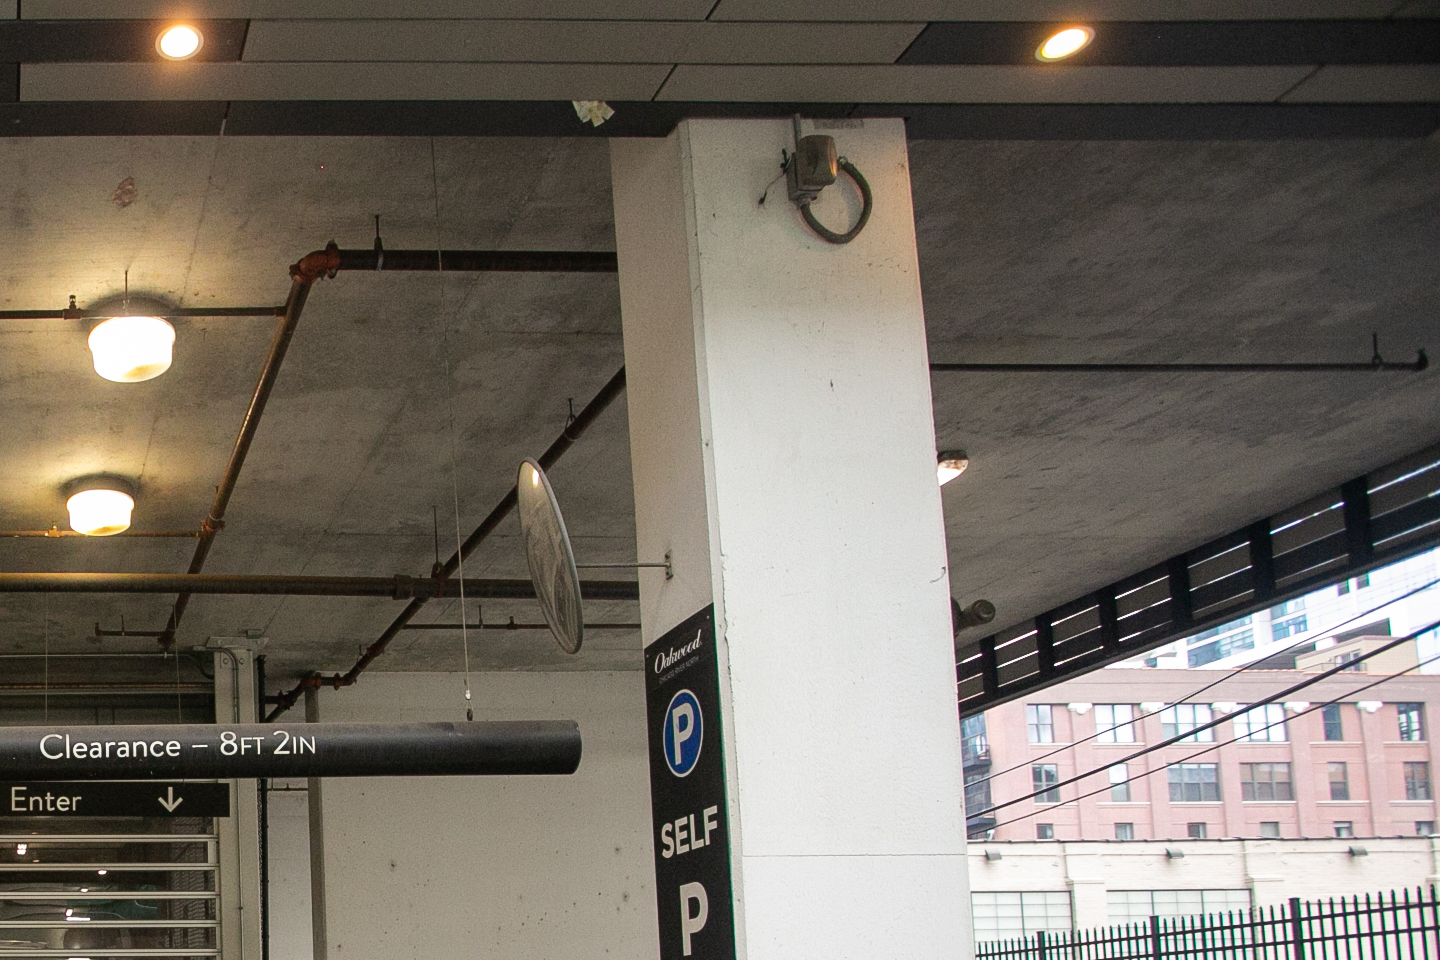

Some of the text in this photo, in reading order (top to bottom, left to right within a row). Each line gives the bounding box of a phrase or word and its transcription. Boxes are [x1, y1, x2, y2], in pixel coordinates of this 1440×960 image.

[654, 629, 701, 673] Oakwood
[40, 733, 181, 759] Clearance
[220, 731, 265, 756] 8FT
[273, 730, 316, 755] 2IN
[672, 702, 694, 765] P
[11, 787, 82, 811] Enter
[661, 805, 718, 858] SELF
